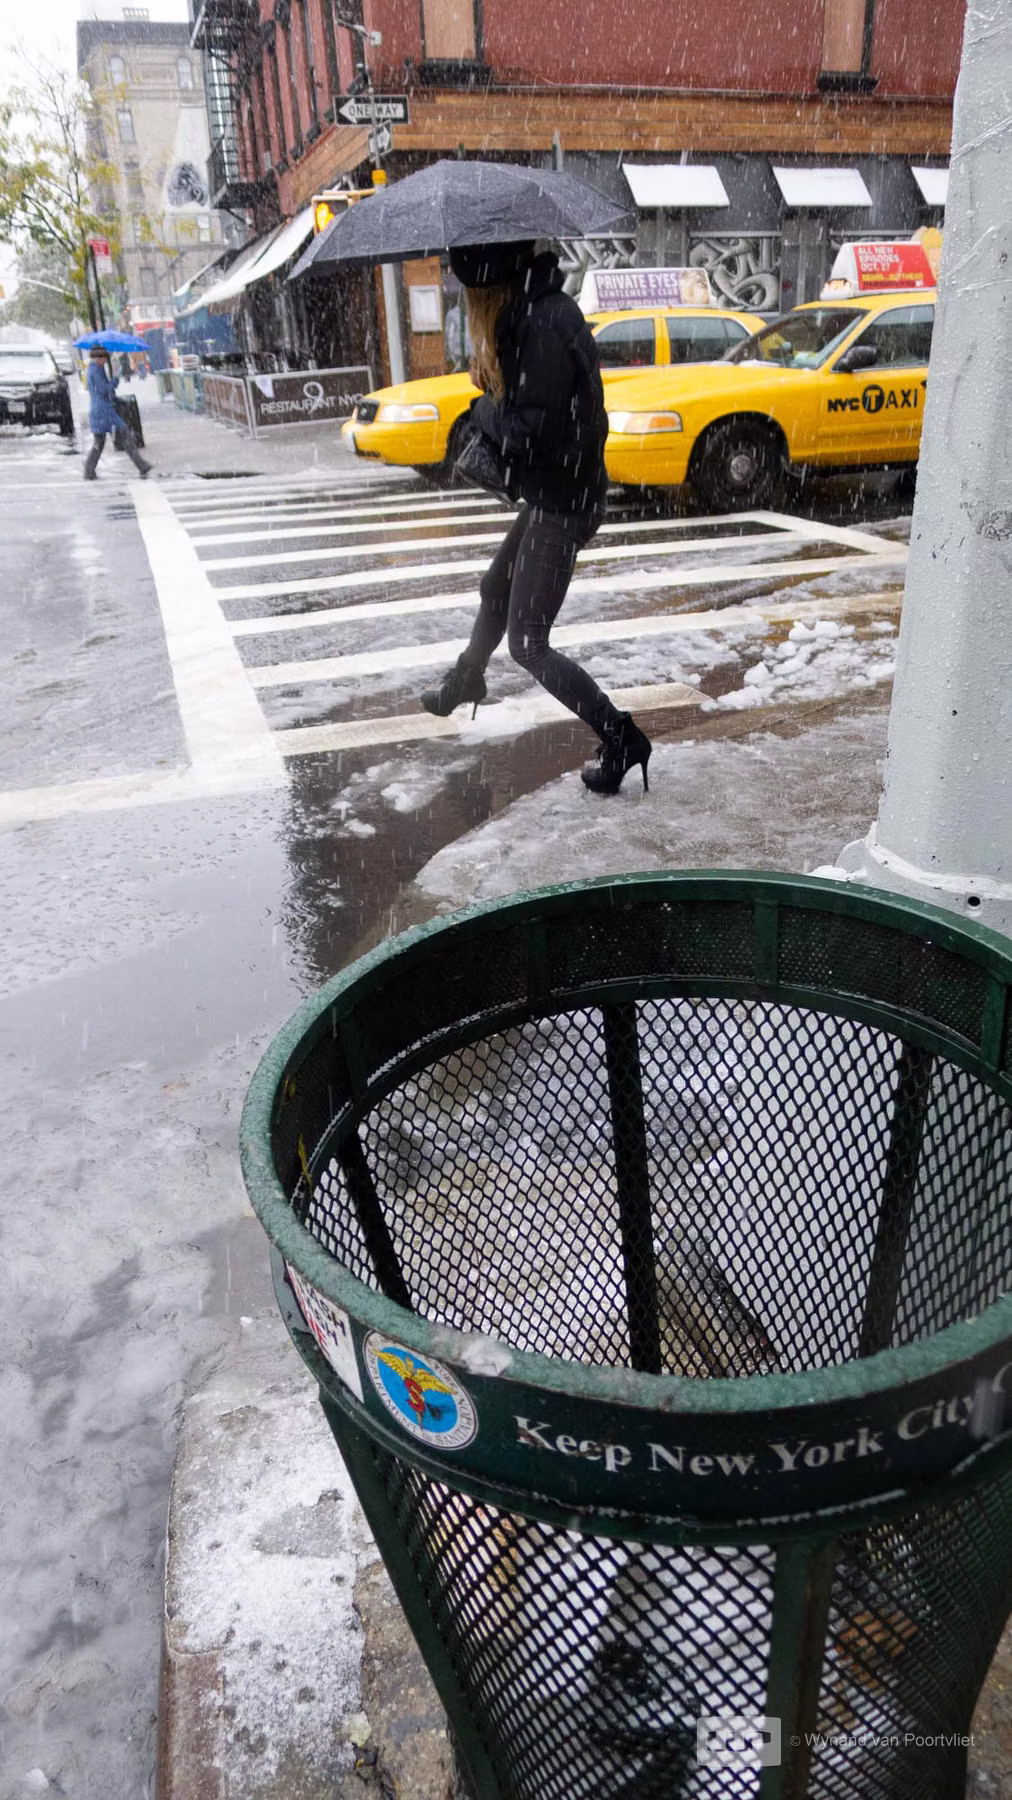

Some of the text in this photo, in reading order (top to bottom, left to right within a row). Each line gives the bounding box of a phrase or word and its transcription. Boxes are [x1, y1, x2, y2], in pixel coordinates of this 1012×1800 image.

[348, 103, 398, 116] ONE WAY
[858, 246, 894, 255] ALL NEW
[859, 254, 900, 263] EPISODES
[596, 272, 678, 289] PRIVATE EYES
[260, 393, 364, 414] RESTAURANT NYC
[827, 398, 860, 412] NYC
[513, 1395, 975, 1476] Keep New York City
